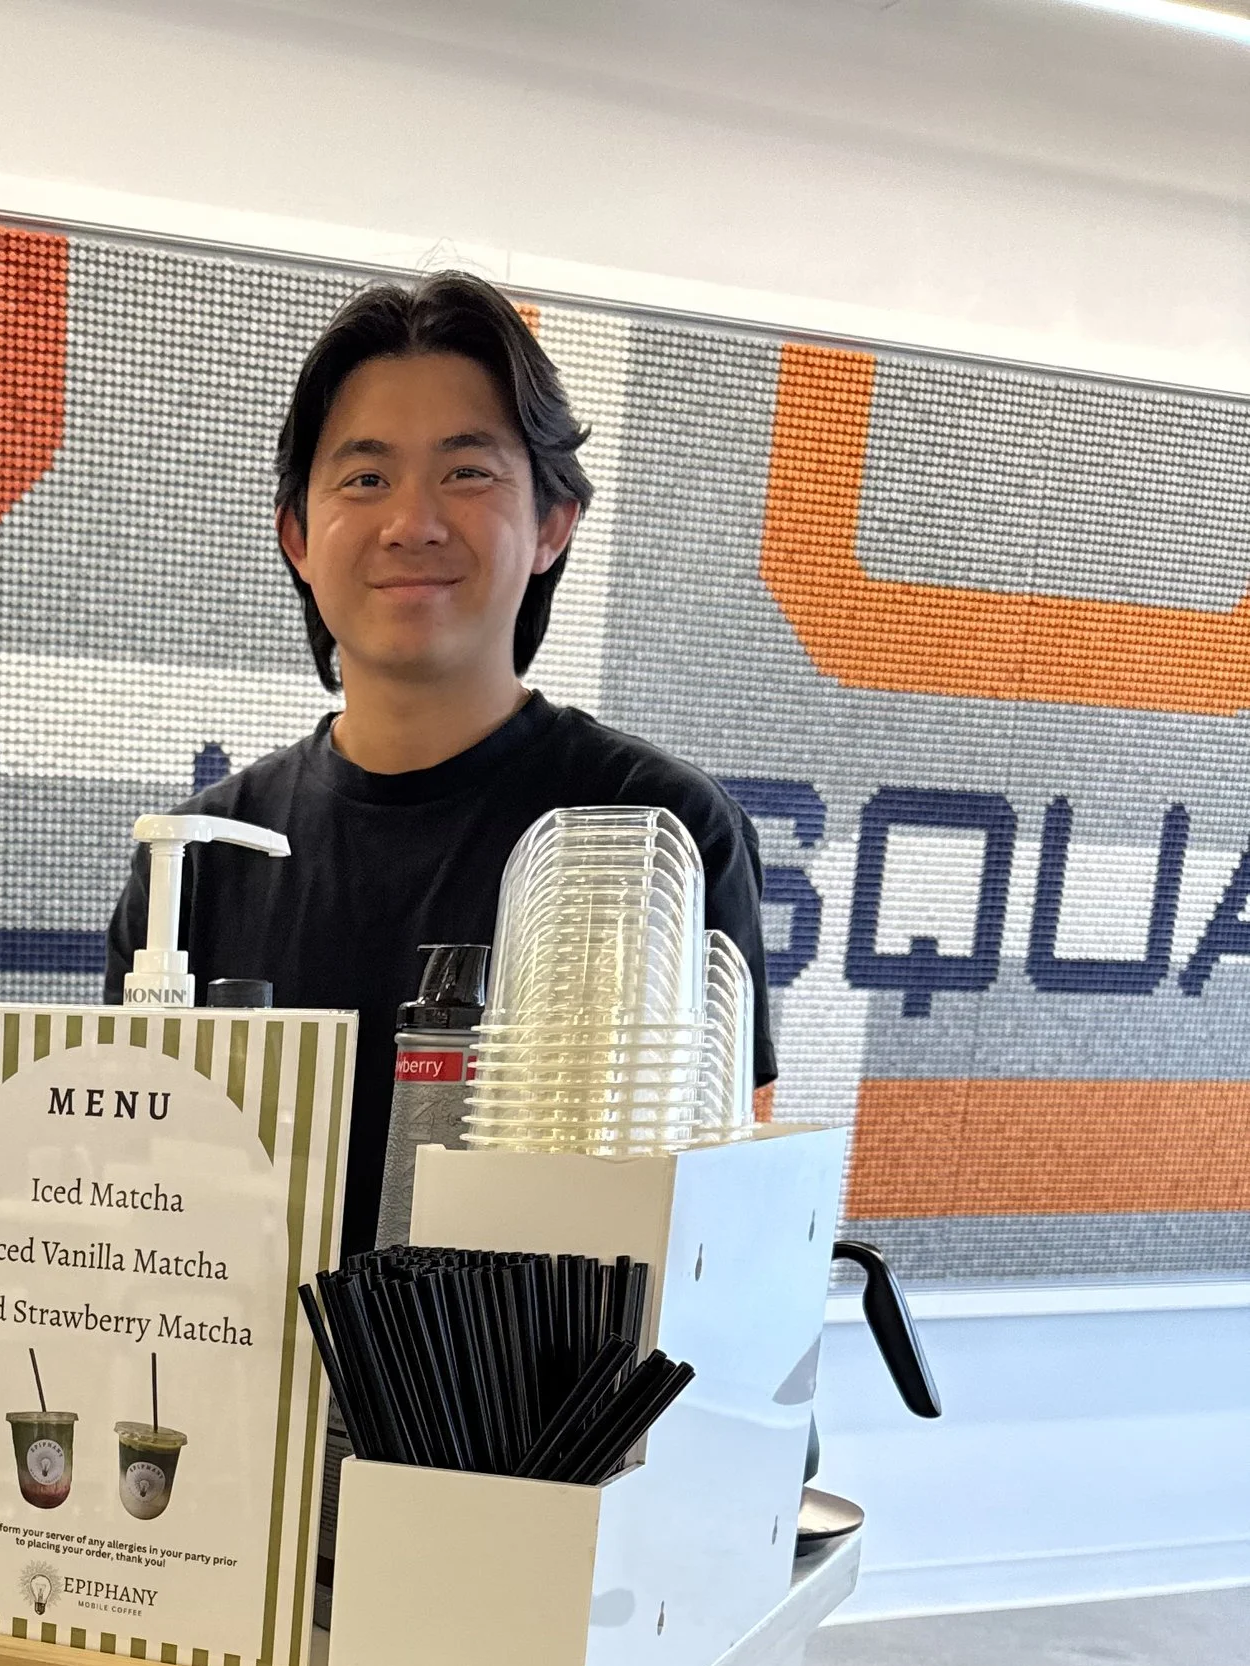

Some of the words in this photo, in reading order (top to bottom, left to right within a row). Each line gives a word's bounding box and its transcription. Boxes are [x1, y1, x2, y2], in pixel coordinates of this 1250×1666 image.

[48, 1087, 171, 1120] MENU
[31, 1178, 83, 1205] Iced
[90, 1182, 184, 1213] Matcha
[41, 1240, 126, 1272] Vanilla
[133, 1248, 229, 1280] Matcha
[13, 1299, 151, 1343] Strawberry
[157, 1313, 254, 1346] Matcha
[16, 1537, 26, 1546] to
[27, 1539, 61, 1554] placing
[62, 1544, 84, 1555] your
[85, 1546, 114, 1561] order,
[116, 1551, 143, 1564] thank
[144, 1557, 166, 1568] you!
[22, 1527, 44, 1538] your
[46, 1530, 75, 1543] server
[76, 1535, 87, 1545] of
[88, 1537, 105, 1549] any
[107, 1540, 147, 1554] allergies
[149, 1545, 158, 1556] in
[160, 1548, 183, 1559] your
[184, 1551, 211, 1566] party
[213, 1556, 238, 1567] prior
[63, 1576, 159, 1607] EPIPHANY
[77, 1600, 109, 1612] MOBILE
[111, 1605, 143, 1617] COFFEE
